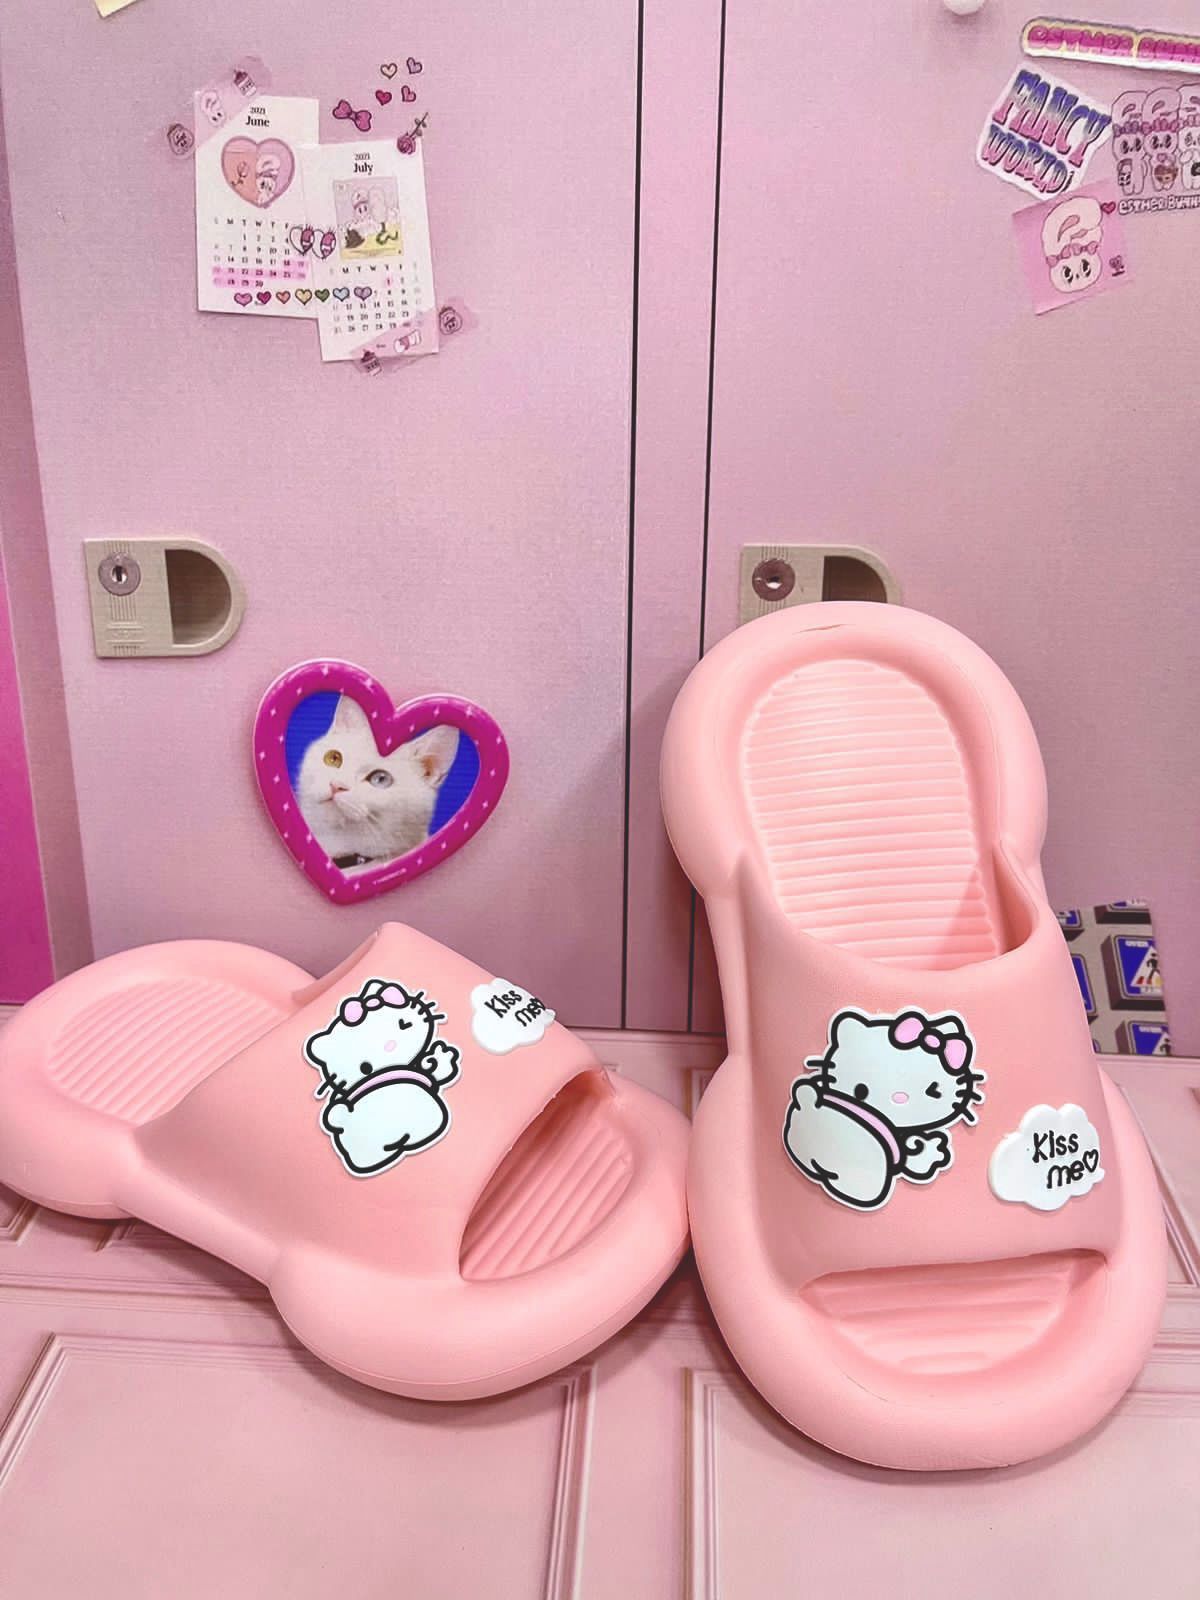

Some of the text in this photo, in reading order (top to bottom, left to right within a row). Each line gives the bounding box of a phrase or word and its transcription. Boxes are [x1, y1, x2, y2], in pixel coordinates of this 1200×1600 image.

[245, 115, 270, 128] June
[250, 106, 266, 115] 2021
[992, 69, 1112, 168] FANCY
[353, 162, 373, 175] July
[354, 152, 370, 161] 2021
[981, 123, 1070, 194] WORLD
[484, 989, 523, 1018] Kiss
[1032, 1130, 1079, 1163] Kiss
[1046, 1160, 1085, 1189] me
